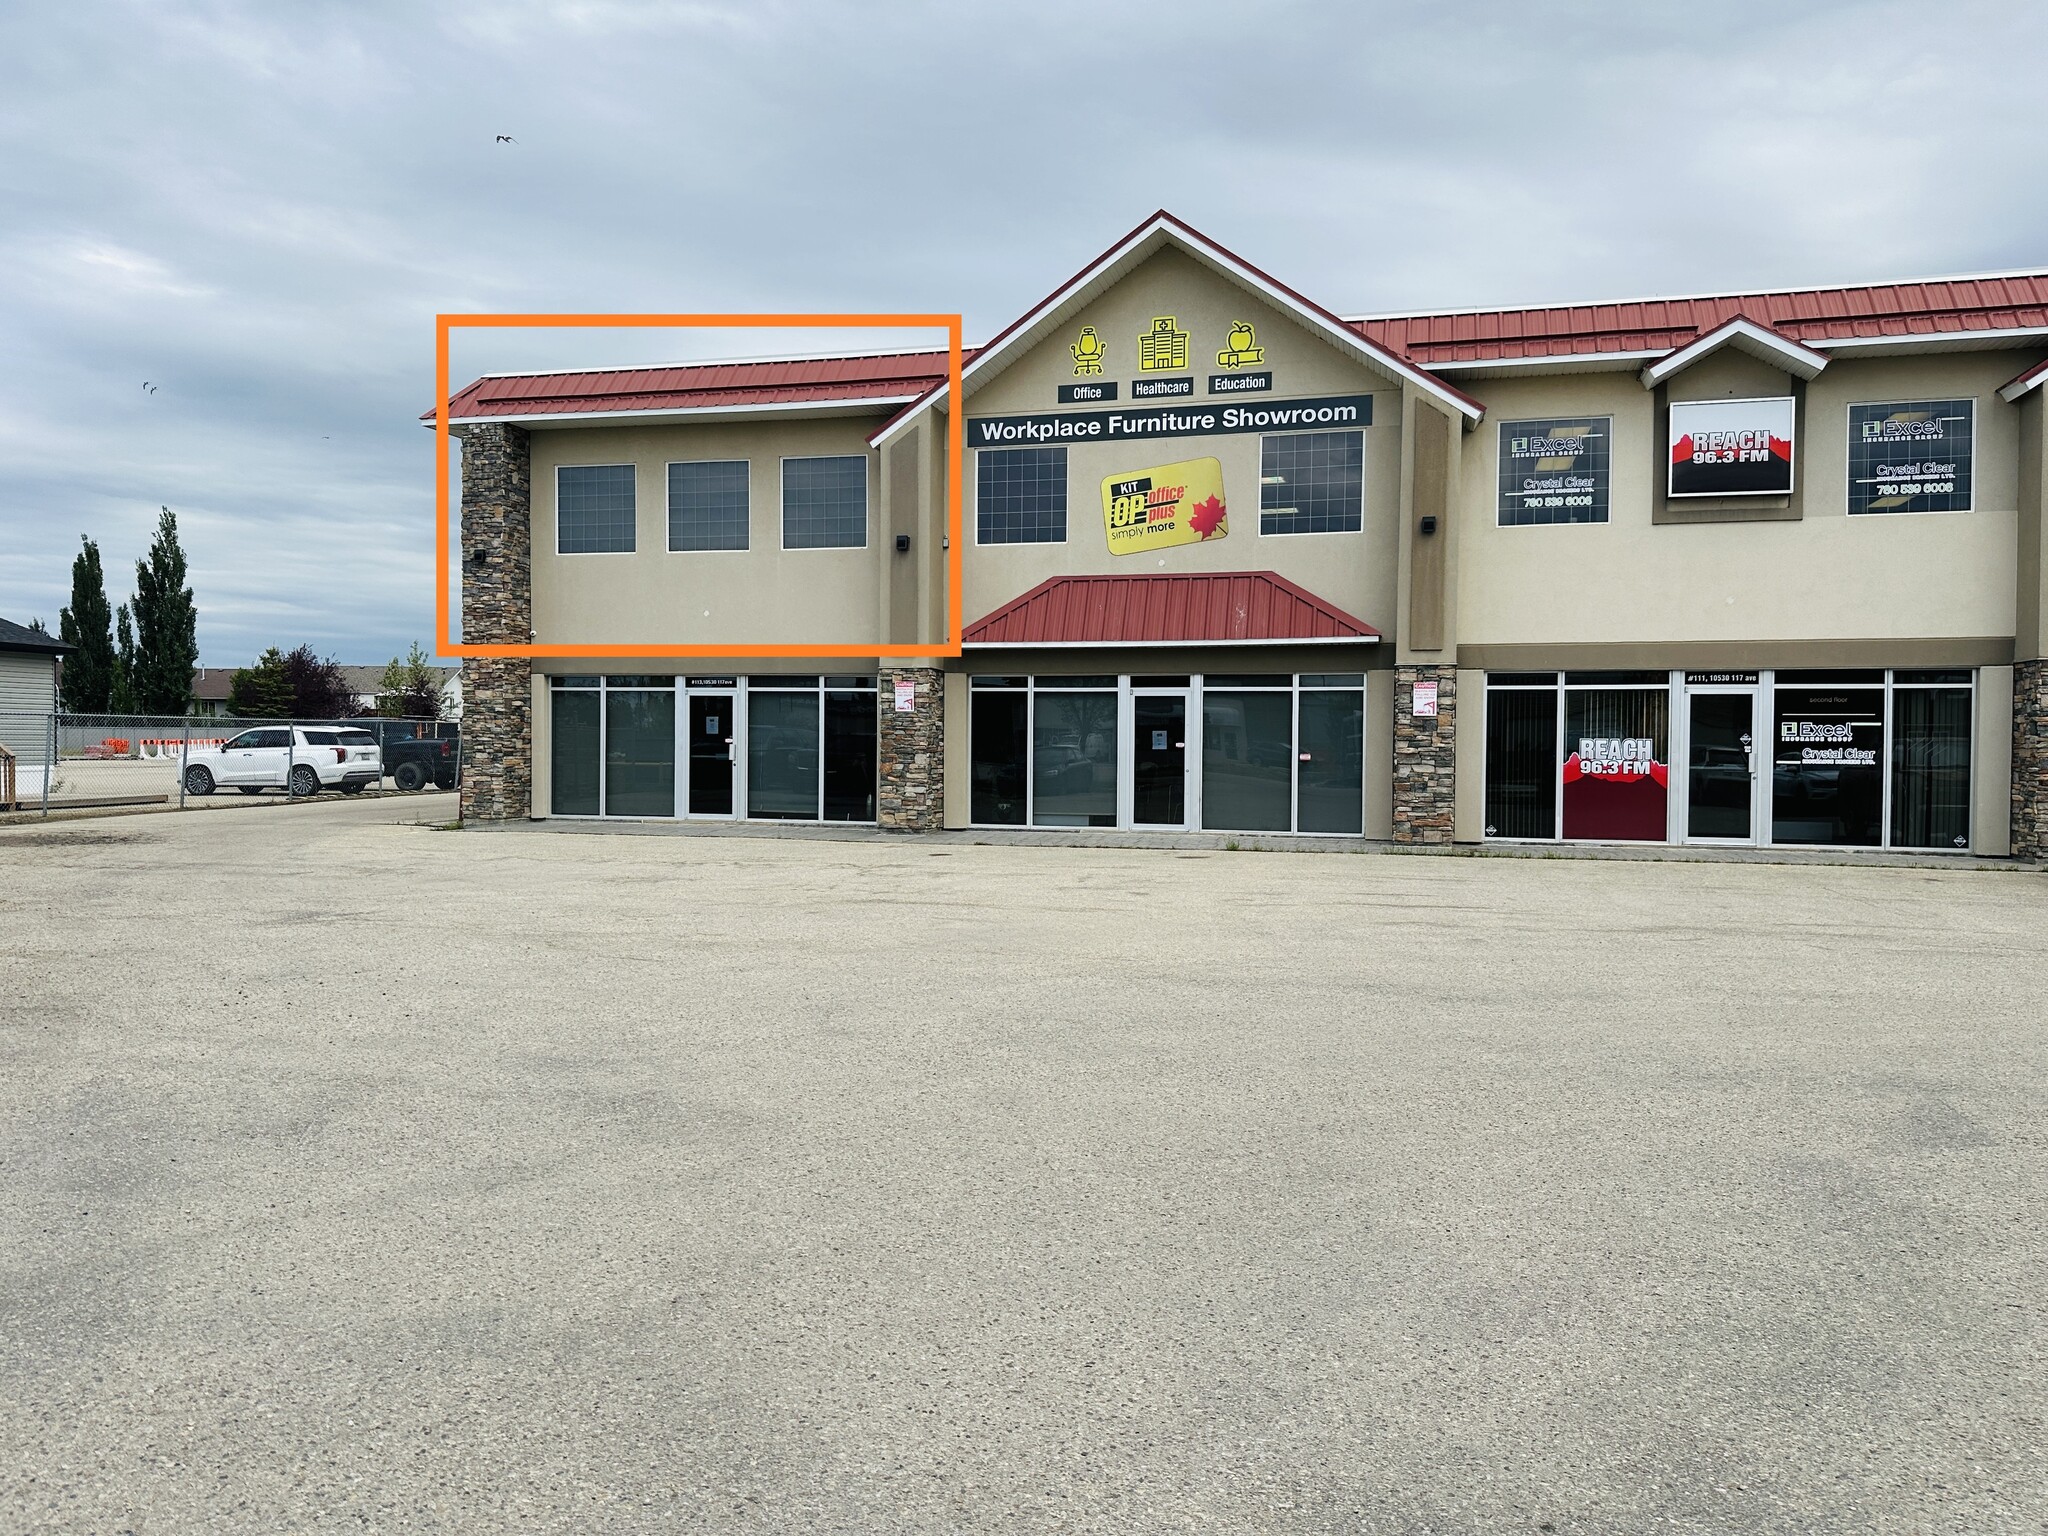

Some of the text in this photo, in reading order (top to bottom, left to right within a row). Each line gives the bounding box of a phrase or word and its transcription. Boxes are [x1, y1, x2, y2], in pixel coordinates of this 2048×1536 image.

[1136, 381, 1189, 396] Healthcare
[1215, 376, 1265, 391] Education
[1073, 387, 1102, 399] Office
[981, 405, 1357, 441] Workplace Furniture Showroom
[1883, 418, 1943, 436] Excel
[1530, 435, 1584, 452] Excel
[1693, 430, 1770, 451] REACH
[1692, 449, 1769, 464] 96.3 FM
[1876, 462, 1956, 477] Crystal Clear
[1120, 481, 1138, 495] KIT
[1523, 476, 1595, 490] Crystal Clear
[1148, 486, 1185, 504] office
[1112, 494, 1145, 527] OP
[1149, 505, 1176, 524] plus
[1111, 521, 1175, 540] simply more
[1709, 674, 1730, 682] 10530
[1731, 674, 1744, 682] 117
[1800, 722, 1853, 737] Excel
[1579, 738, 1652, 760] REACH
[1802, 747, 1876, 760] Crystal Clear
[1580, 760, 1651, 775] 96.3 FM
